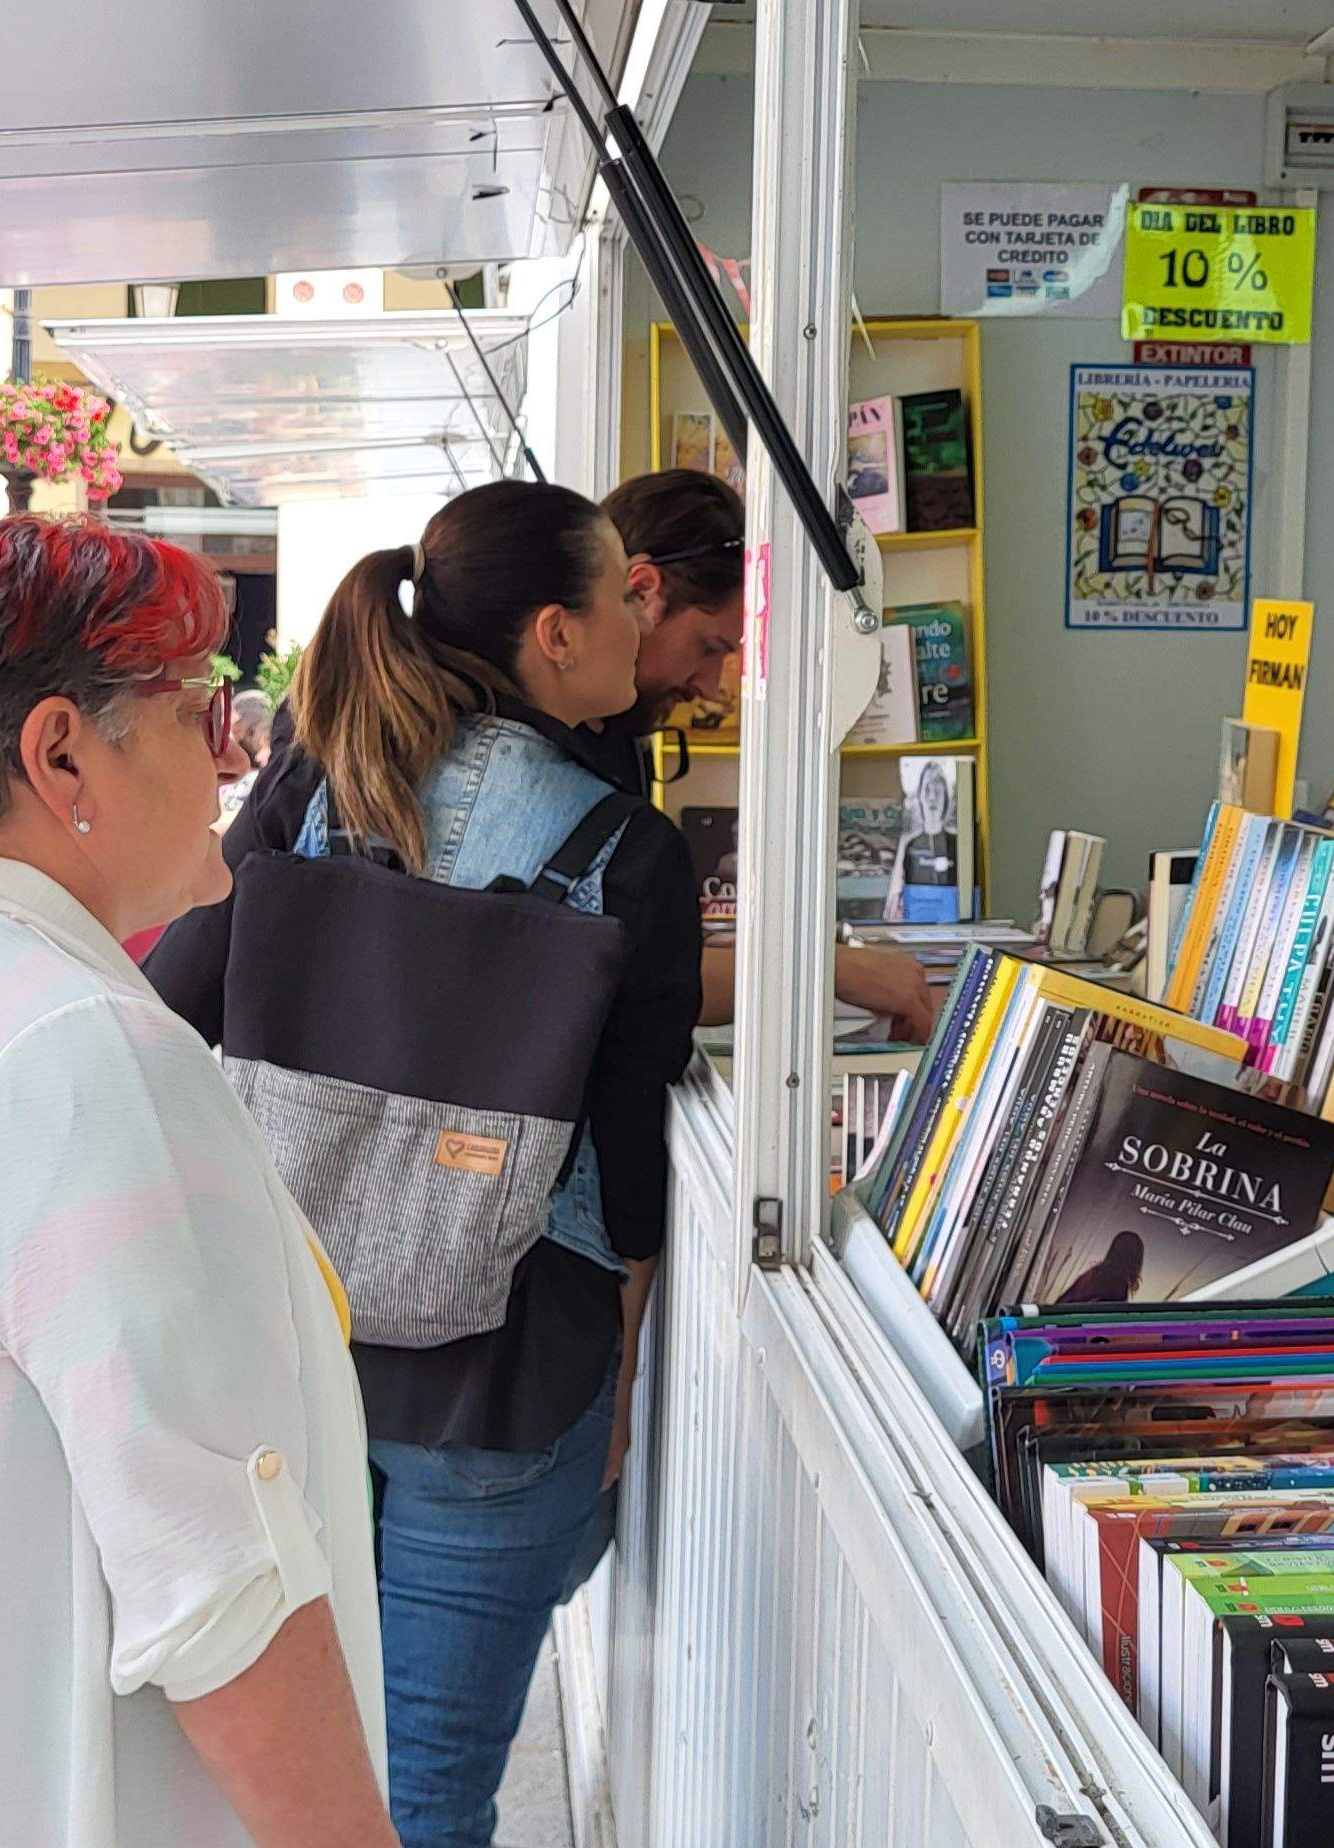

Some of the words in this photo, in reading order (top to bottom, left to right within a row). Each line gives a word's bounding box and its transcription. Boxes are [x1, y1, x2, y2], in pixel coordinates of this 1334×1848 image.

[963, 212, 984, 226] SE
[989, 212, 1043, 227] PUEDE
[1048, 213, 1104, 227] PAGAR
[1186, 213, 1221, 233] DEL
[1234, 214, 1295, 235] LIBRO
[965, 231, 1000, 244] CON
[1005, 231, 1075, 245] TARJETA
[1079, 232, 1101, 245] DE
[1159, 248, 1210, 289] 10
[1227, 252, 1267, 291] %
[1144, 307, 1283, 331] DESCUENTO
[1141, 345, 1243, 364] EXTINTOR
[1123, 611, 1219, 623] DESCUENTO
[1265, 612, 1299, 641] HOY
[1249, 659, 1305, 690] FIRMAN
[1195, 1132, 1227, 1157] La
[1118, 1135, 1284, 1213] SOBRINA
[1131, 1183, 1175, 1209] María
[1178, 1199, 1216, 1222] Pilar
[1218, 1212, 1253, 1234] Clau
